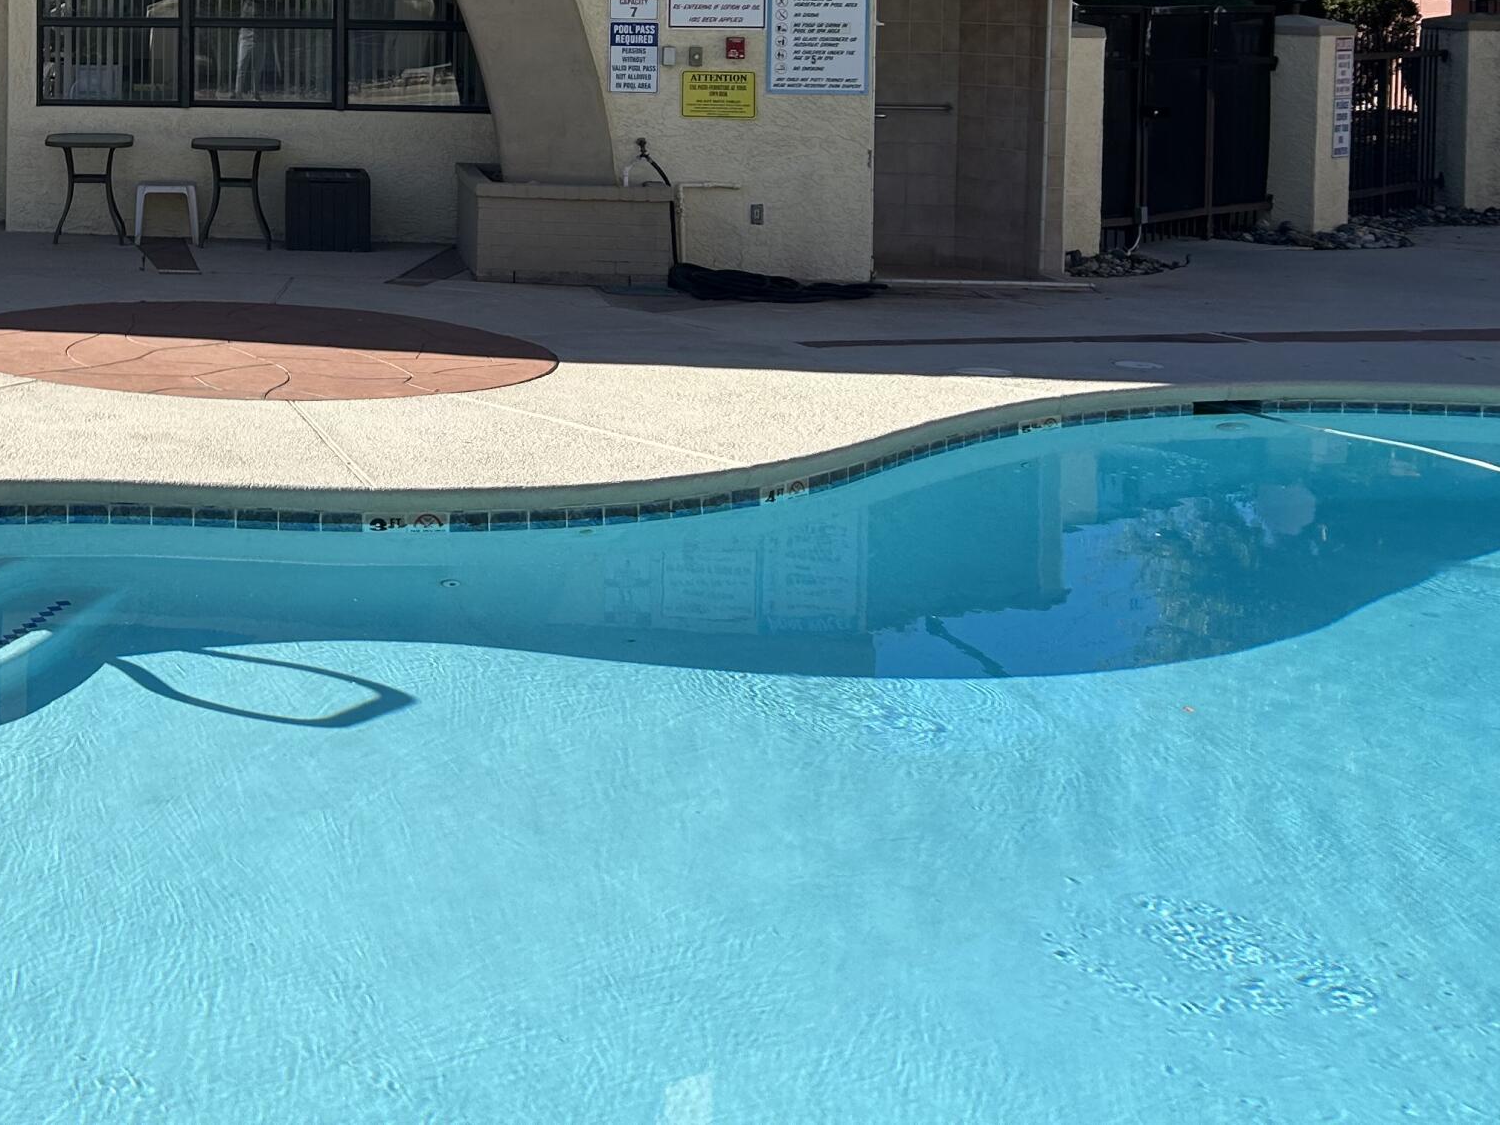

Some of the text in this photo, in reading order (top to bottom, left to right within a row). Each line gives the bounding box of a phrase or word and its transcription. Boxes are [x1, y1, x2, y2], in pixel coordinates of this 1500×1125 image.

[630, 7, 638, 17] 7
[614, 25, 655, 34] POOL PASS
[616, 35, 653, 45] REQUIRED
[811, 55, 816, 64] 5
[370, 518, 387, 531] 3
